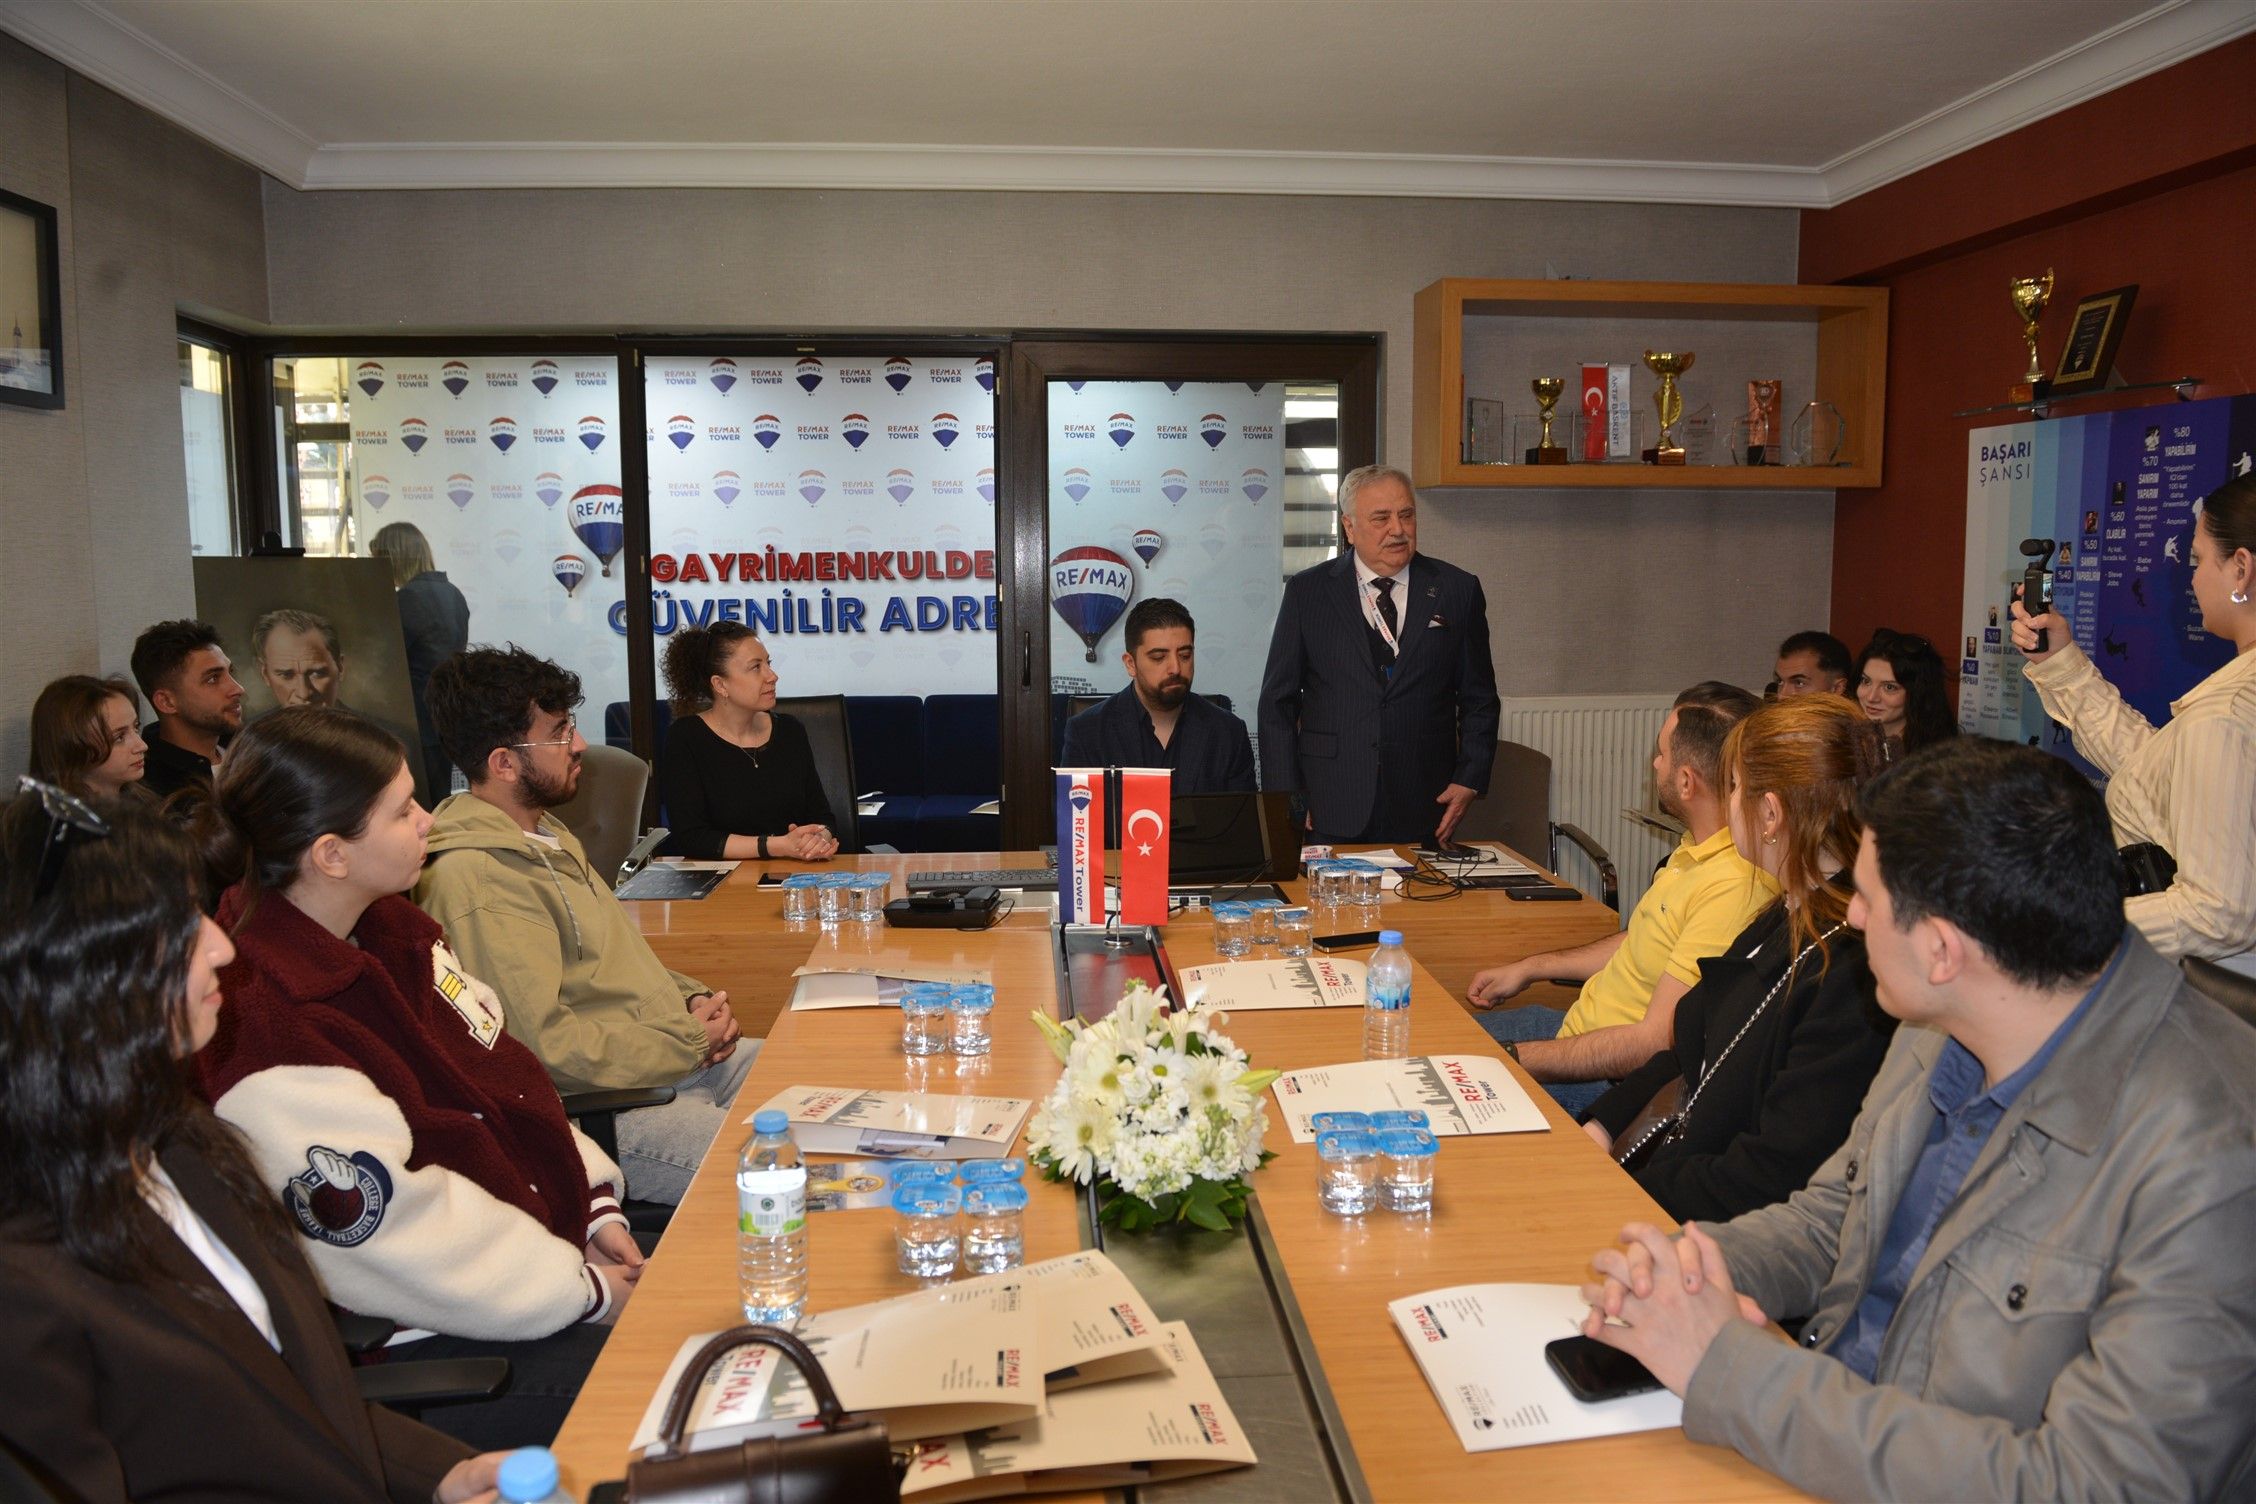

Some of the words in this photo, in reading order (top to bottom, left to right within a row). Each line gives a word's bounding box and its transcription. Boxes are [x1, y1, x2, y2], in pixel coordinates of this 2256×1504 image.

[402, 426, 425, 434] RE/MAX
[533, 428, 565, 436] RE/MAX
[2174, 426, 2191, 438] %80
[1981, 441, 2031, 464] BAŞARI
[2142, 456, 2159, 467] %70
[1980, 464, 2030, 487] ŞANSI
[576, 501, 623, 518] RE/MA
[2110, 511, 2125, 522] %60
[1135, 536, 1160, 545] RE/MAX
[2084, 540, 2098, 550] %50
[556, 562, 583, 570] RE/MAX
[651, 544, 994, 581] GAYRİMENKULDE
[1056, 568, 1127, 589] RE/MAX
[2058, 570, 2072, 580] %40
[880, 595, 998, 632] ADRE
[1075, 818, 1085, 865] RE/MAX
[1074, 867, 1083, 912] Tower
[1317, 961, 1342, 988] RE/MAX
[1341, 972, 1353, 986] Tower
[1442, 1061, 1483, 1102] RE/MAX
[1479, 1081, 1498, 1100] Tower
[360, 1177, 379, 1211] COLLEGE
[327, 1214, 376, 1242] BASKETBALL
[1117, 1303, 1148, 1337] RE/MAX
[1411, 1306, 1441, 1343] RE/MAX
[1006, 1349, 1020, 1388] RE/MAX
[713, 1348, 767, 1416] RE/MAX
[1199, 1402, 1228, 1446] RE/MAX
